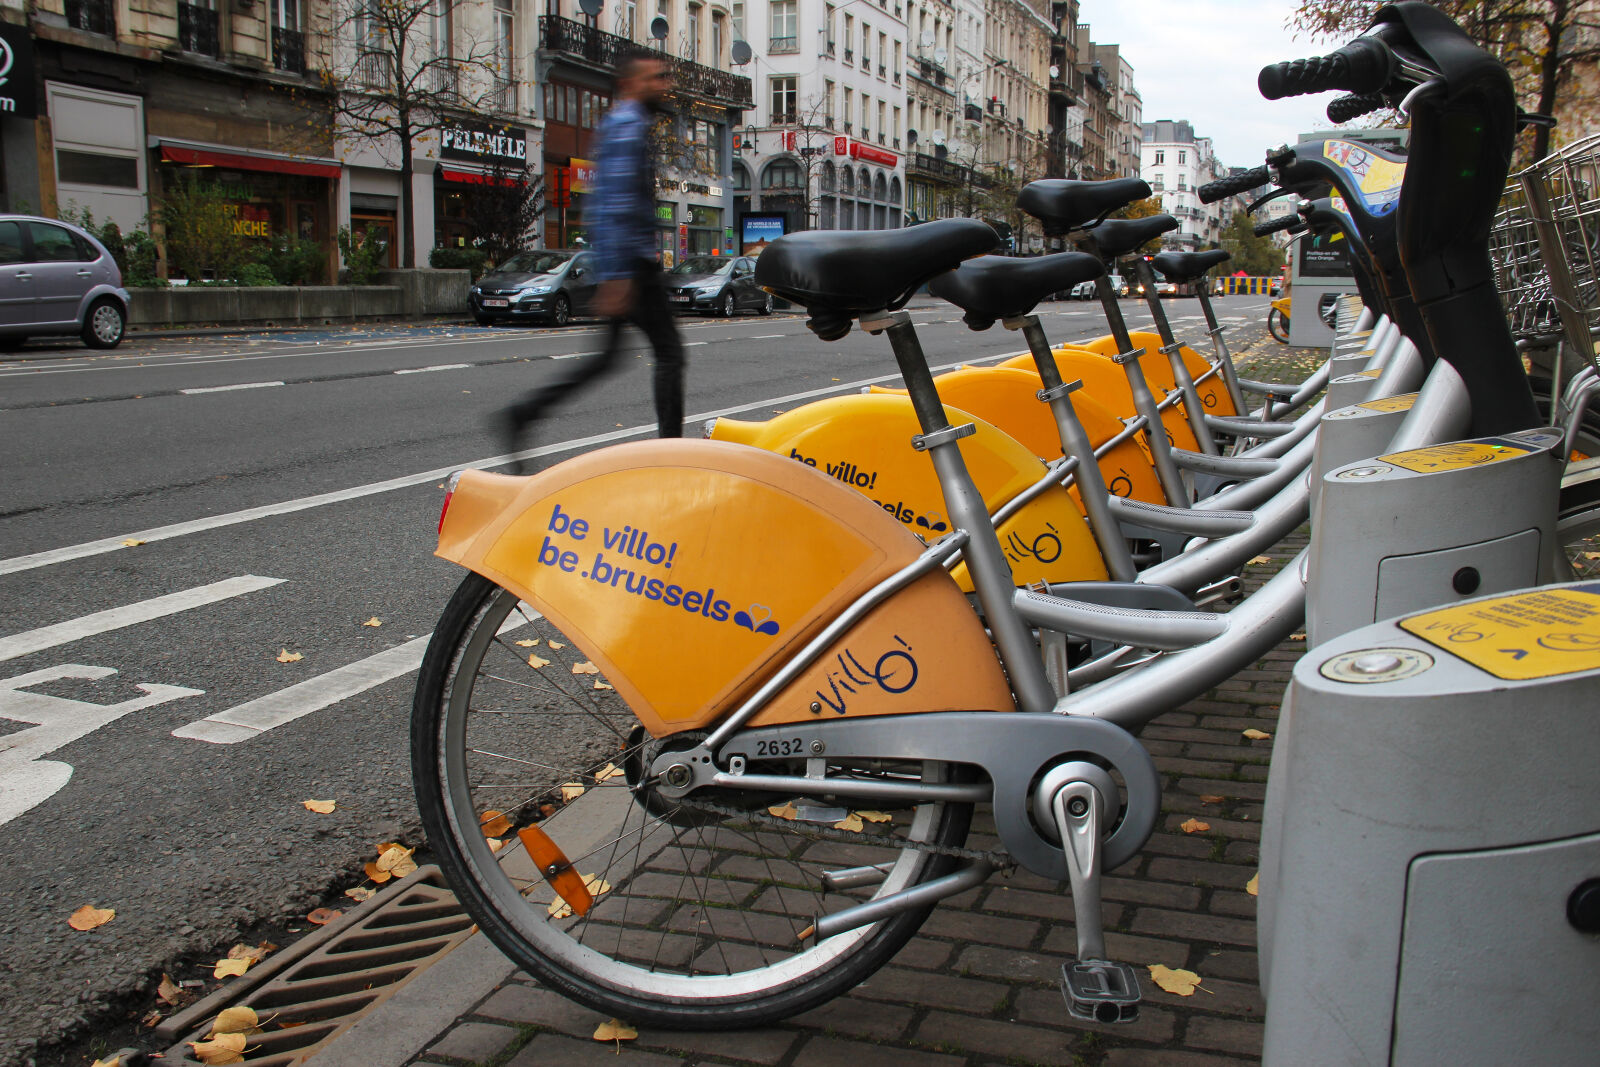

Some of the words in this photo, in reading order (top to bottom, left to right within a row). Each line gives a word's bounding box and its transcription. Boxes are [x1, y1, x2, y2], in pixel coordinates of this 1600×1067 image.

[826, 461, 878, 490] villo!
[547, 503, 589, 542] be
[603, 523, 678, 570] villo!
[756, 737, 804, 756] 2632
